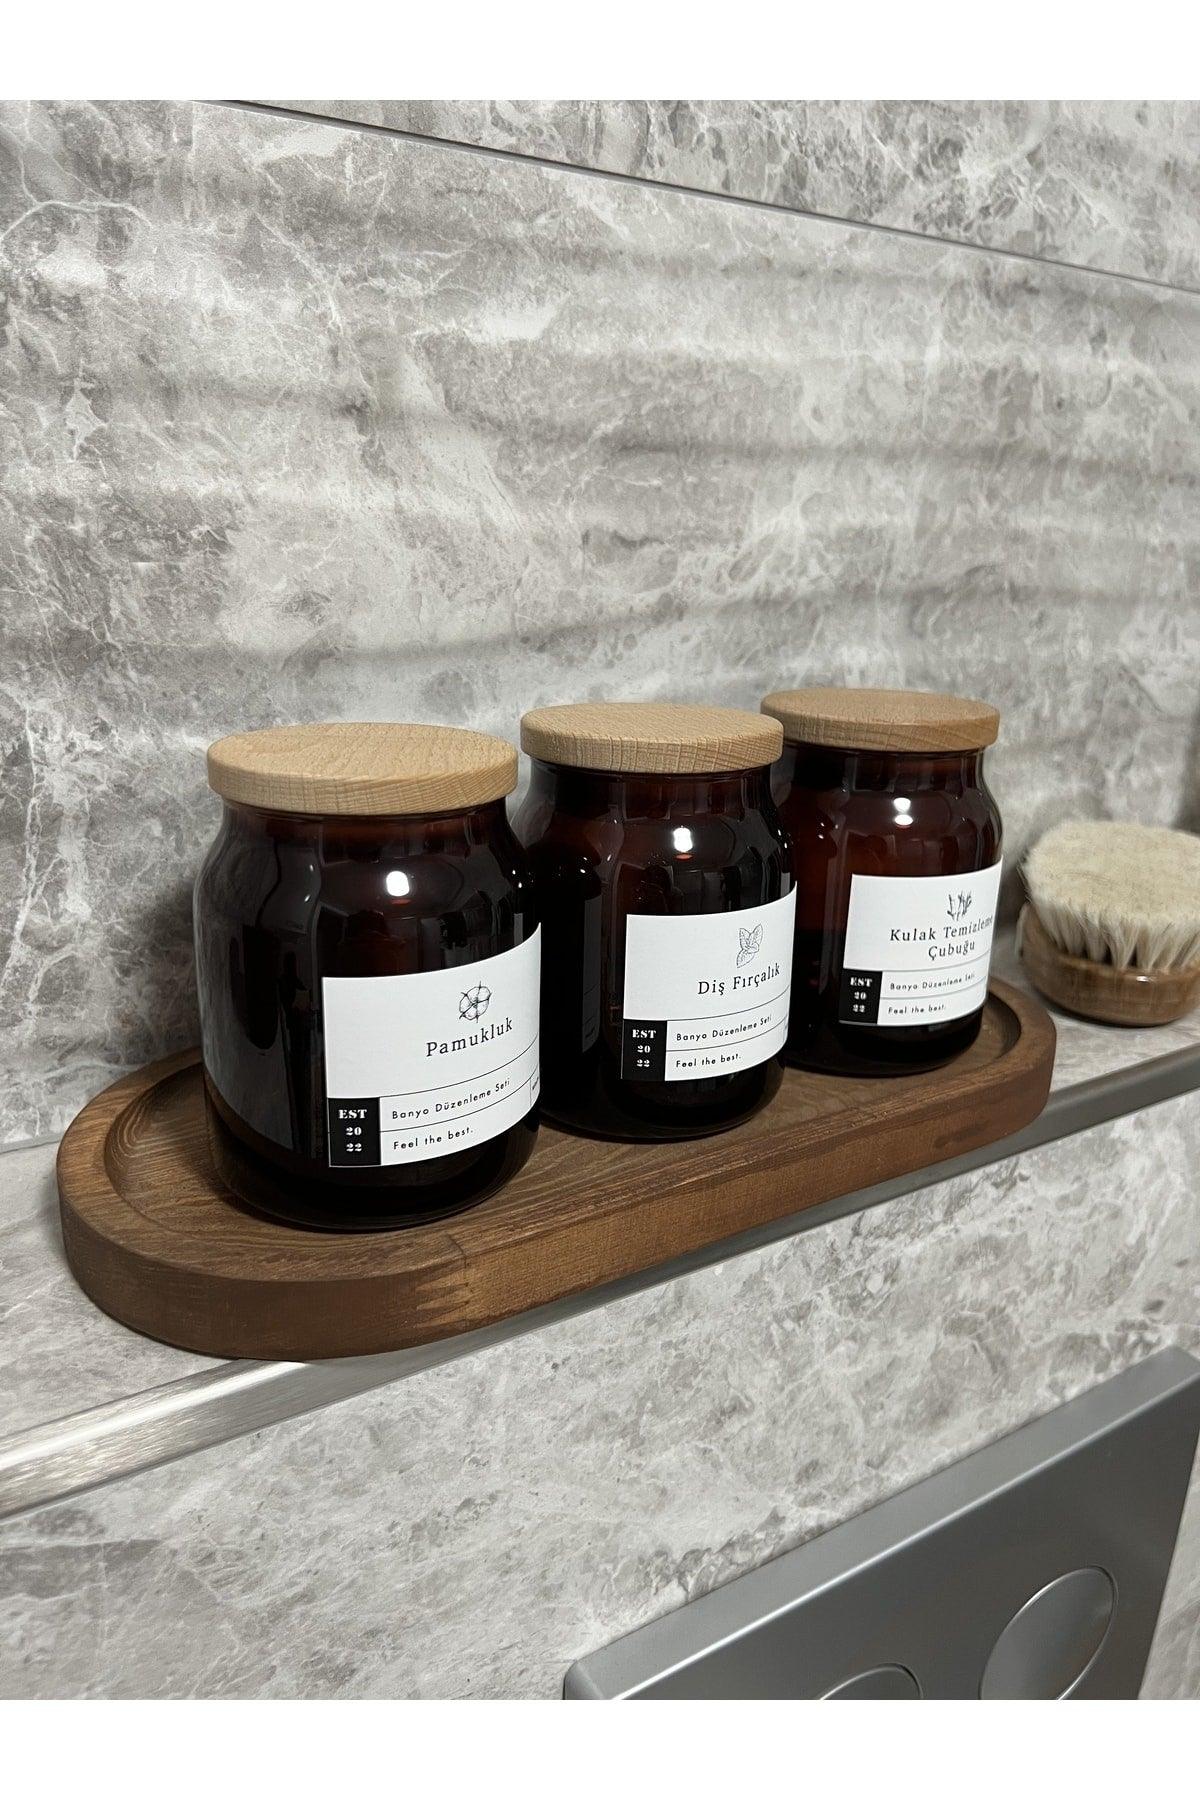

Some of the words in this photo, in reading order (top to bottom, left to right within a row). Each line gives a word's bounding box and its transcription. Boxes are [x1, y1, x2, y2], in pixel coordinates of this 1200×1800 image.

[890, 928, 936, 942] Kulak
[928, 940, 975, 961] Çubuğu
[697, 980, 725, 995] Diş
[732, 963, 780, 990] Fırçalık
[850, 977, 872, 987] EST
[890, 982, 918, 992] Banyo
[922, 976, 962, 989] Düzenleme
[854, 991, 867, 1000] 20
[852, 1004, 865, 1013] 22
[888, 1006, 907, 1014] Feel
[911, 1005, 924, 1013] the
[426, 1017, 513, 1057] Pamukluk
[632, 1029, 657, 1039] EST
[676, 1032, 707, 1042] Banyo
[712, 1022, 757, 1038] Düzenleme
[637, 1044, 651, 1053] 20
[636, 1059, 650, 1068] 22
[676, 1059, 697, 1068] Feel
[701, 1056, 716, 1066] the
[720, 1053, 742, 1063] best.
[392, 1106, 429, 1120] Banyo
[435, 1089, 492, 1112] Düzenleme
[495, 1079, 511, 1092] Seti
[338, 1109, 367, 1119] EST
[346, 1126, 362, 1136] 20
[393, 1138, 418, 1150] Feel
[425, 1132, 442, 1145] the
[448, 1126, 474, 1139] best.
[346, 1142, 362, 1152] 22
